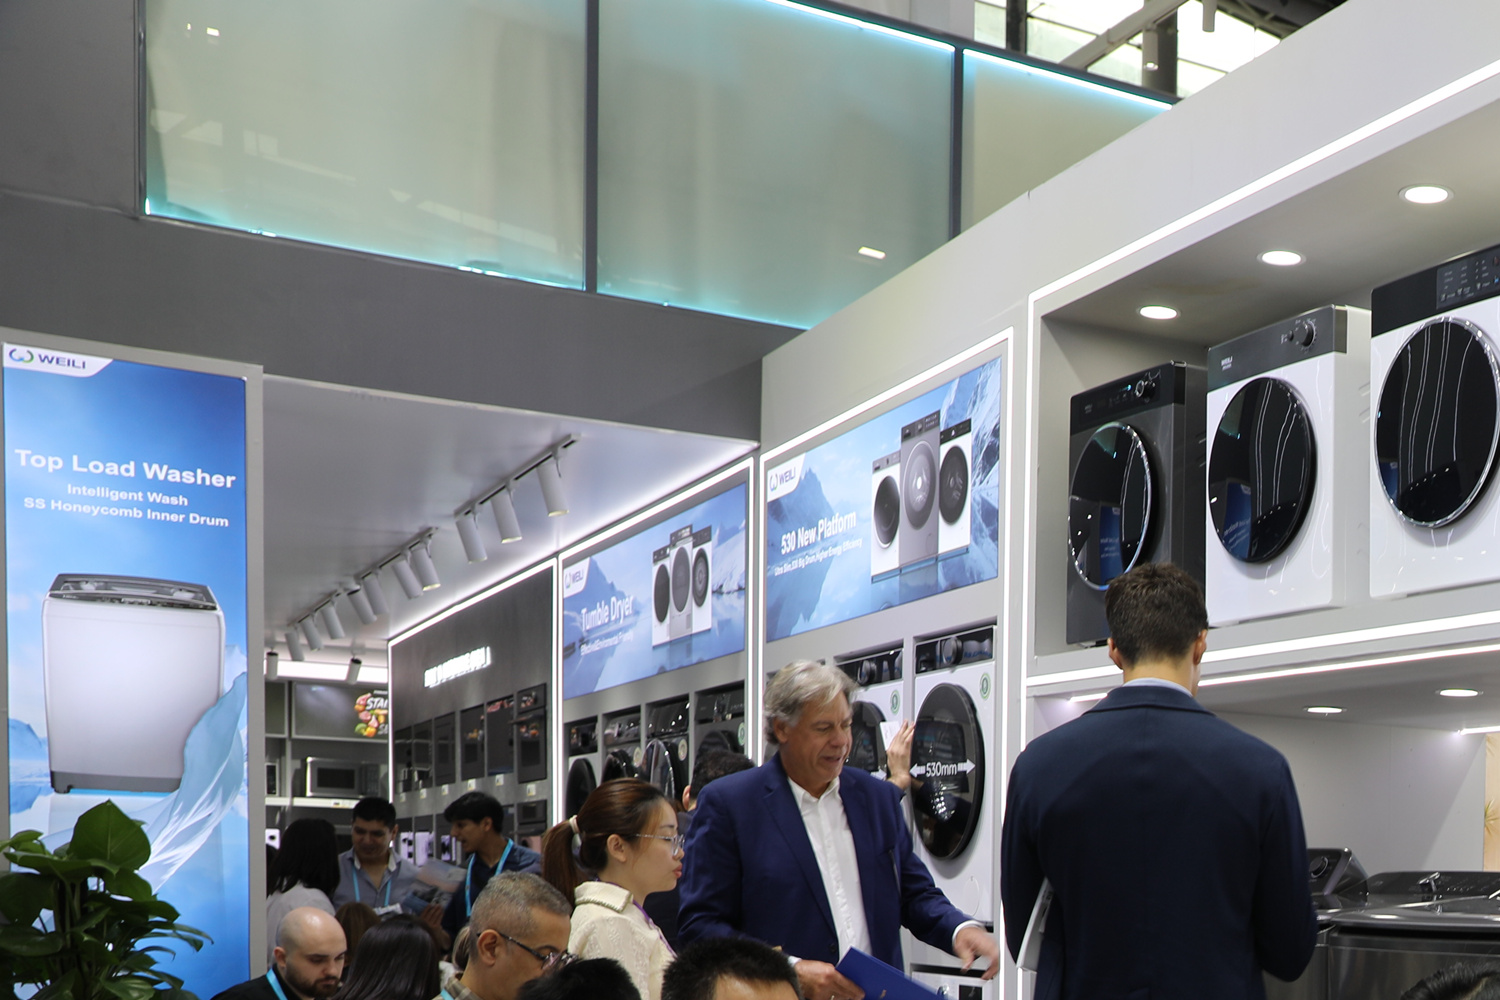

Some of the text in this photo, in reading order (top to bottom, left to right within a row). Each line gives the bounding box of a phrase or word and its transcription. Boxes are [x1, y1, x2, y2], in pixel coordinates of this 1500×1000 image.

[38, 353, 86, 369] WEILI
[14, 449, 236, 488] Top Load Washer
[67, 483, 188, 507] Intelligent Wash
[24, 497, 229, 527] SS Honeycomb Inner Drum
[781, 511, 857, 555] 530 New Platform
[581, 595, 634, 632] Tumble Dryer
[926, 761, 957, 777] 530mm
